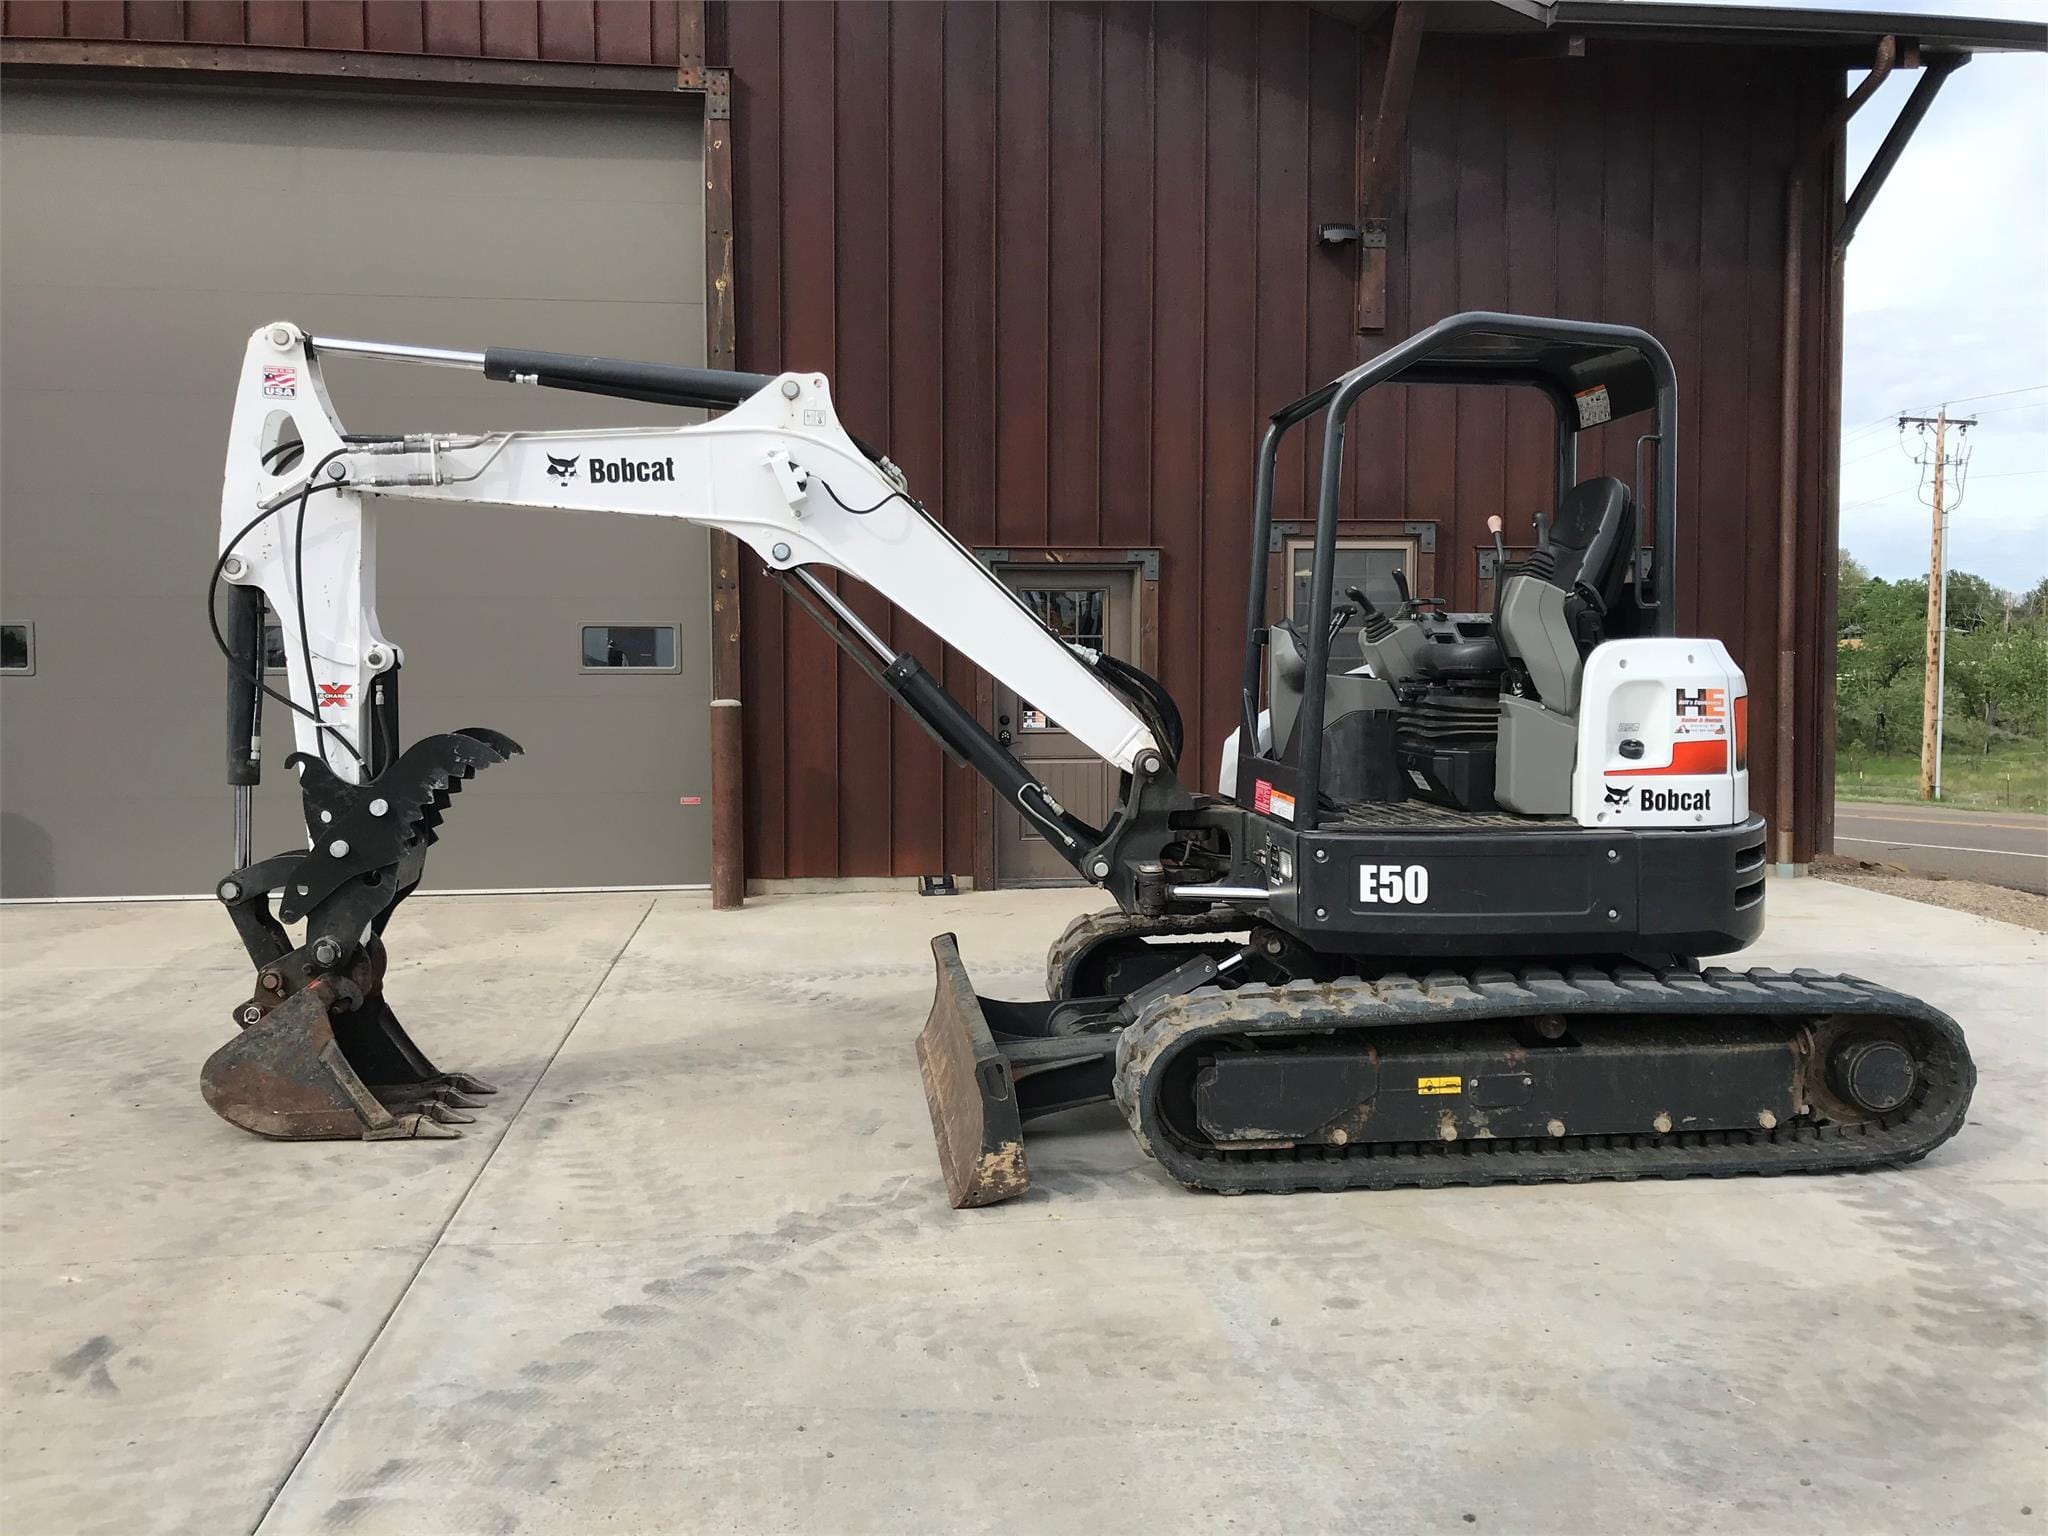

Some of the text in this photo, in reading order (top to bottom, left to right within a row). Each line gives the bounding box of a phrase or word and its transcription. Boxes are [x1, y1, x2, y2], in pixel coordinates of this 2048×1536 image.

[265, 387, 294, 396] USA
[589, 457, 676, 483] Bobcat
[1641, 788, 1711, 811] Bobcat
[1360, 865, 1429, 904] E50
